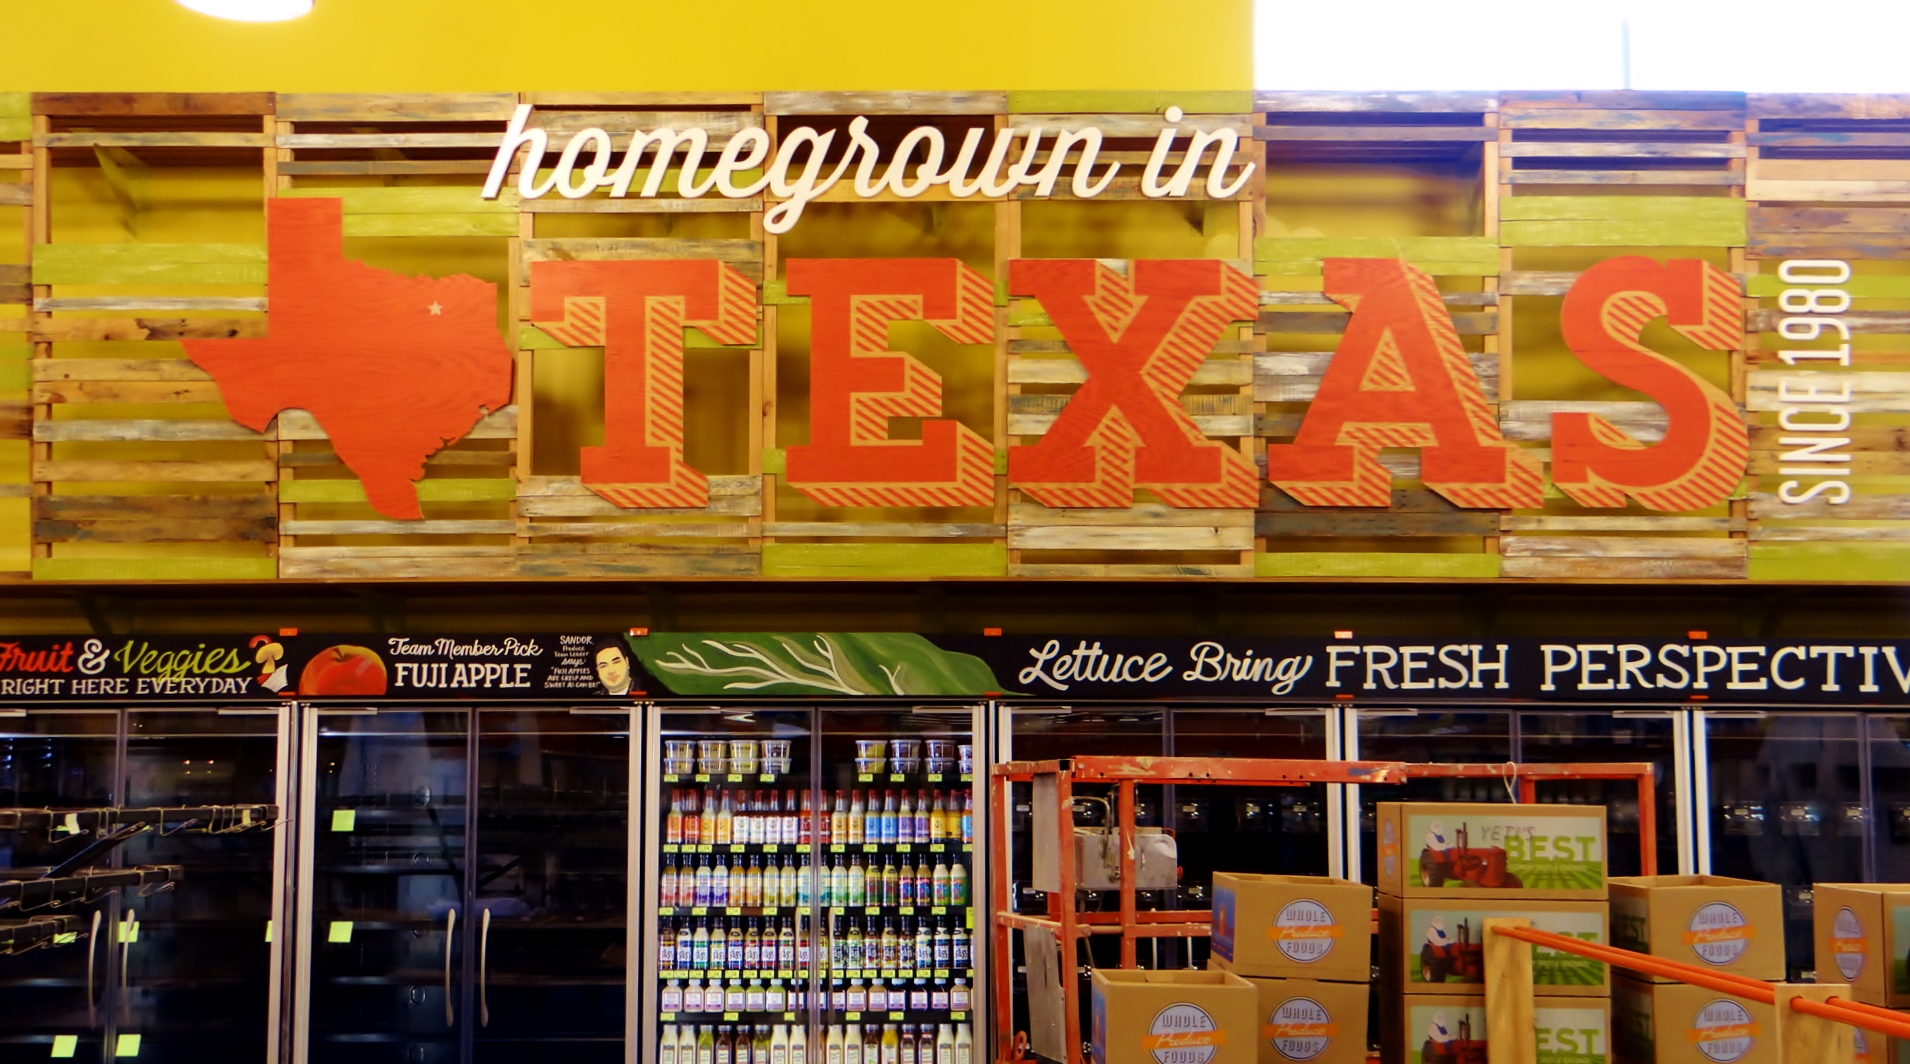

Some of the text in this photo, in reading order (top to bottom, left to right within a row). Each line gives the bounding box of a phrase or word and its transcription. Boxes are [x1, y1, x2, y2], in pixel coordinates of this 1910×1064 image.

[481, 103, 1255, 234] homegrown in
[530, 256, 1750, 511] TEXAS
[1778, 259, 1850, 504] SINCE 1980
[388, 636, 543, 660] Team Member Pick
[0, 639, 252, 683] Fruit & Veggies
[1018, 639, 1173, 691] Lettuce
[1182, 641, 1314, 695] Bring
[1325, 645, 1509, 690] FRESH
[1, 677, 252, 695] RIGHT HERE EVERYDAY
[394, 662, 532, 688] FUJI APPLE
[1503, 835, 1597, 862] BEST
[1286, 909, 1326, 922] WHOLE
[1286, 941, 1323, 954] FOODS
[1162, 1014, 1206, 1028] WHOLE
[1281, 1006, 1322, 1020] WHOLE
[1154, 1027, 1211, 1049] Produce
[1535, 1028, 1600, 1055] EST
[1164, 1050, 1205, 1064] FOODS
